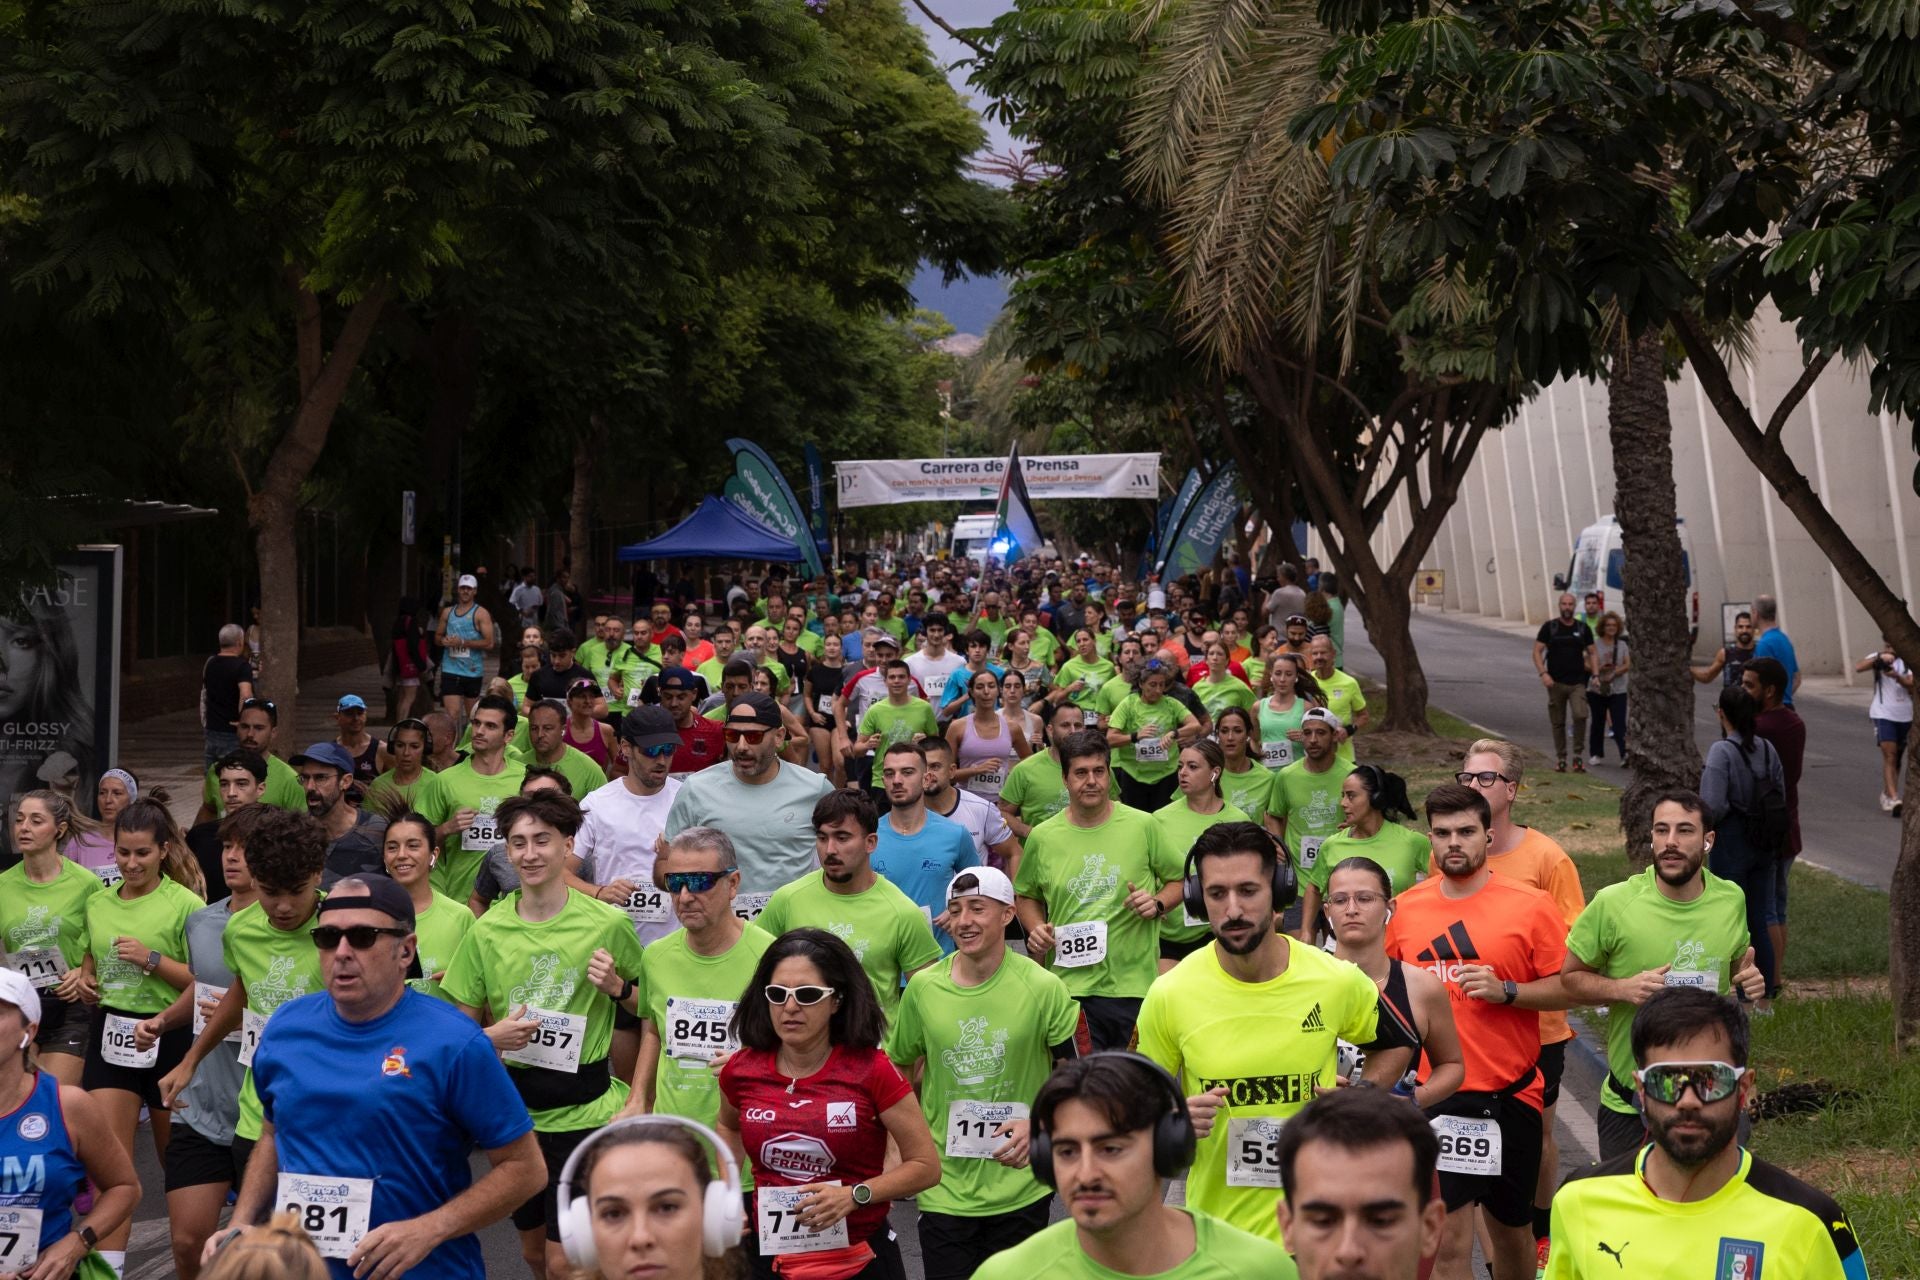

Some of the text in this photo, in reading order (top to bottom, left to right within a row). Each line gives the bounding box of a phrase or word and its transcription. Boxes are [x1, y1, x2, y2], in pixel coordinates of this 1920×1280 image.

[921, 460, 1003, 474] Carrera de
[1026, 459, 1079, 471] Prensa
[1188, 471, 1235, 540] Fundació
[1200, 495, 1237, 545] Unicaja
[20, 578, 88, 607] ASE
[3, 722, 71, 735] GLOSSY
[1140, 746, 1163, 755] 632
[975, 774, 1001, 784] 1080
[1062, 936, 1097, 955] 382
[20, 960, 58, 977] 111
[1422, 959, 1494, 983] did
[674, 1019, 727, 1042] 845
[827, 1114, 852, 1125] AXA
[1438, 1134, 1490, 1157] 669
[772, 1147, 827, 1165] PONLE
[0, 1154, 45, 1193] M
[770, 1157, 824, 1173] FRENO
[1728, 1246, 1753, 1255] ITALIA
